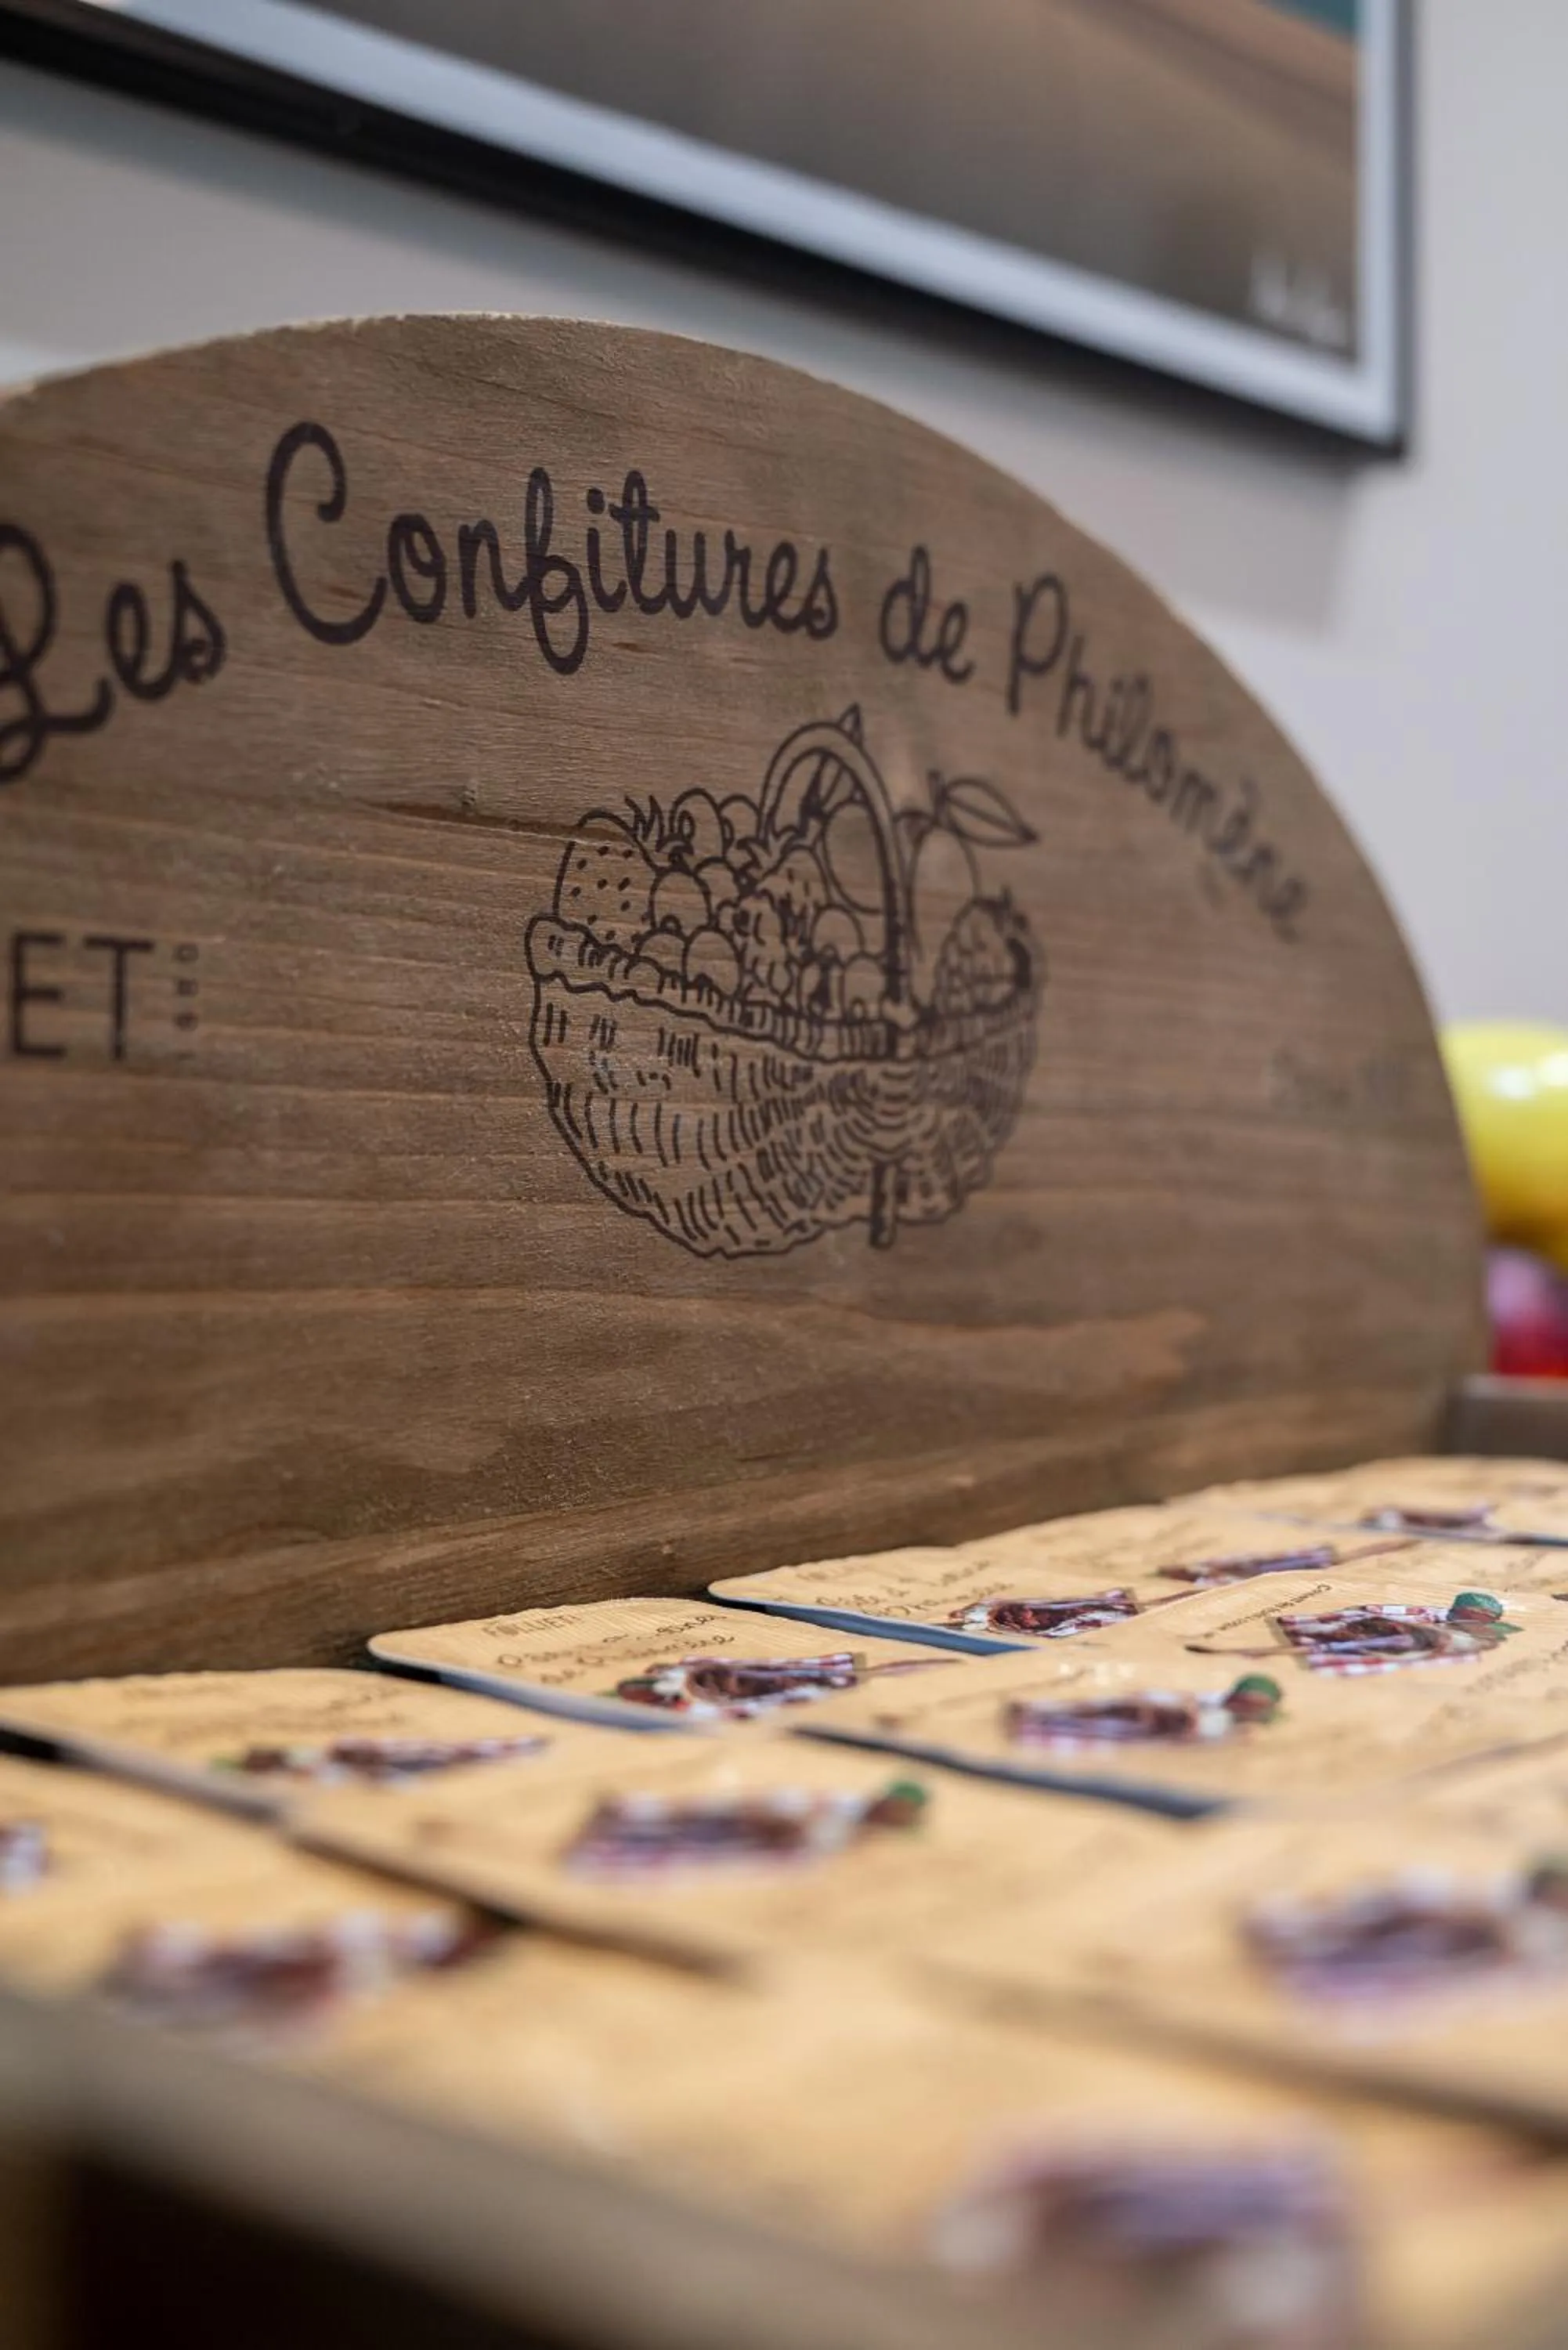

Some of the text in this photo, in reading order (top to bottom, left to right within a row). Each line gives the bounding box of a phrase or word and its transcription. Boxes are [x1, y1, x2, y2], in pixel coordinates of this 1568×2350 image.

[266, 421, 838, 676] Confitures
[879, 545, 974, 684] de
[1006, 573, 1307, 943] Philomène
